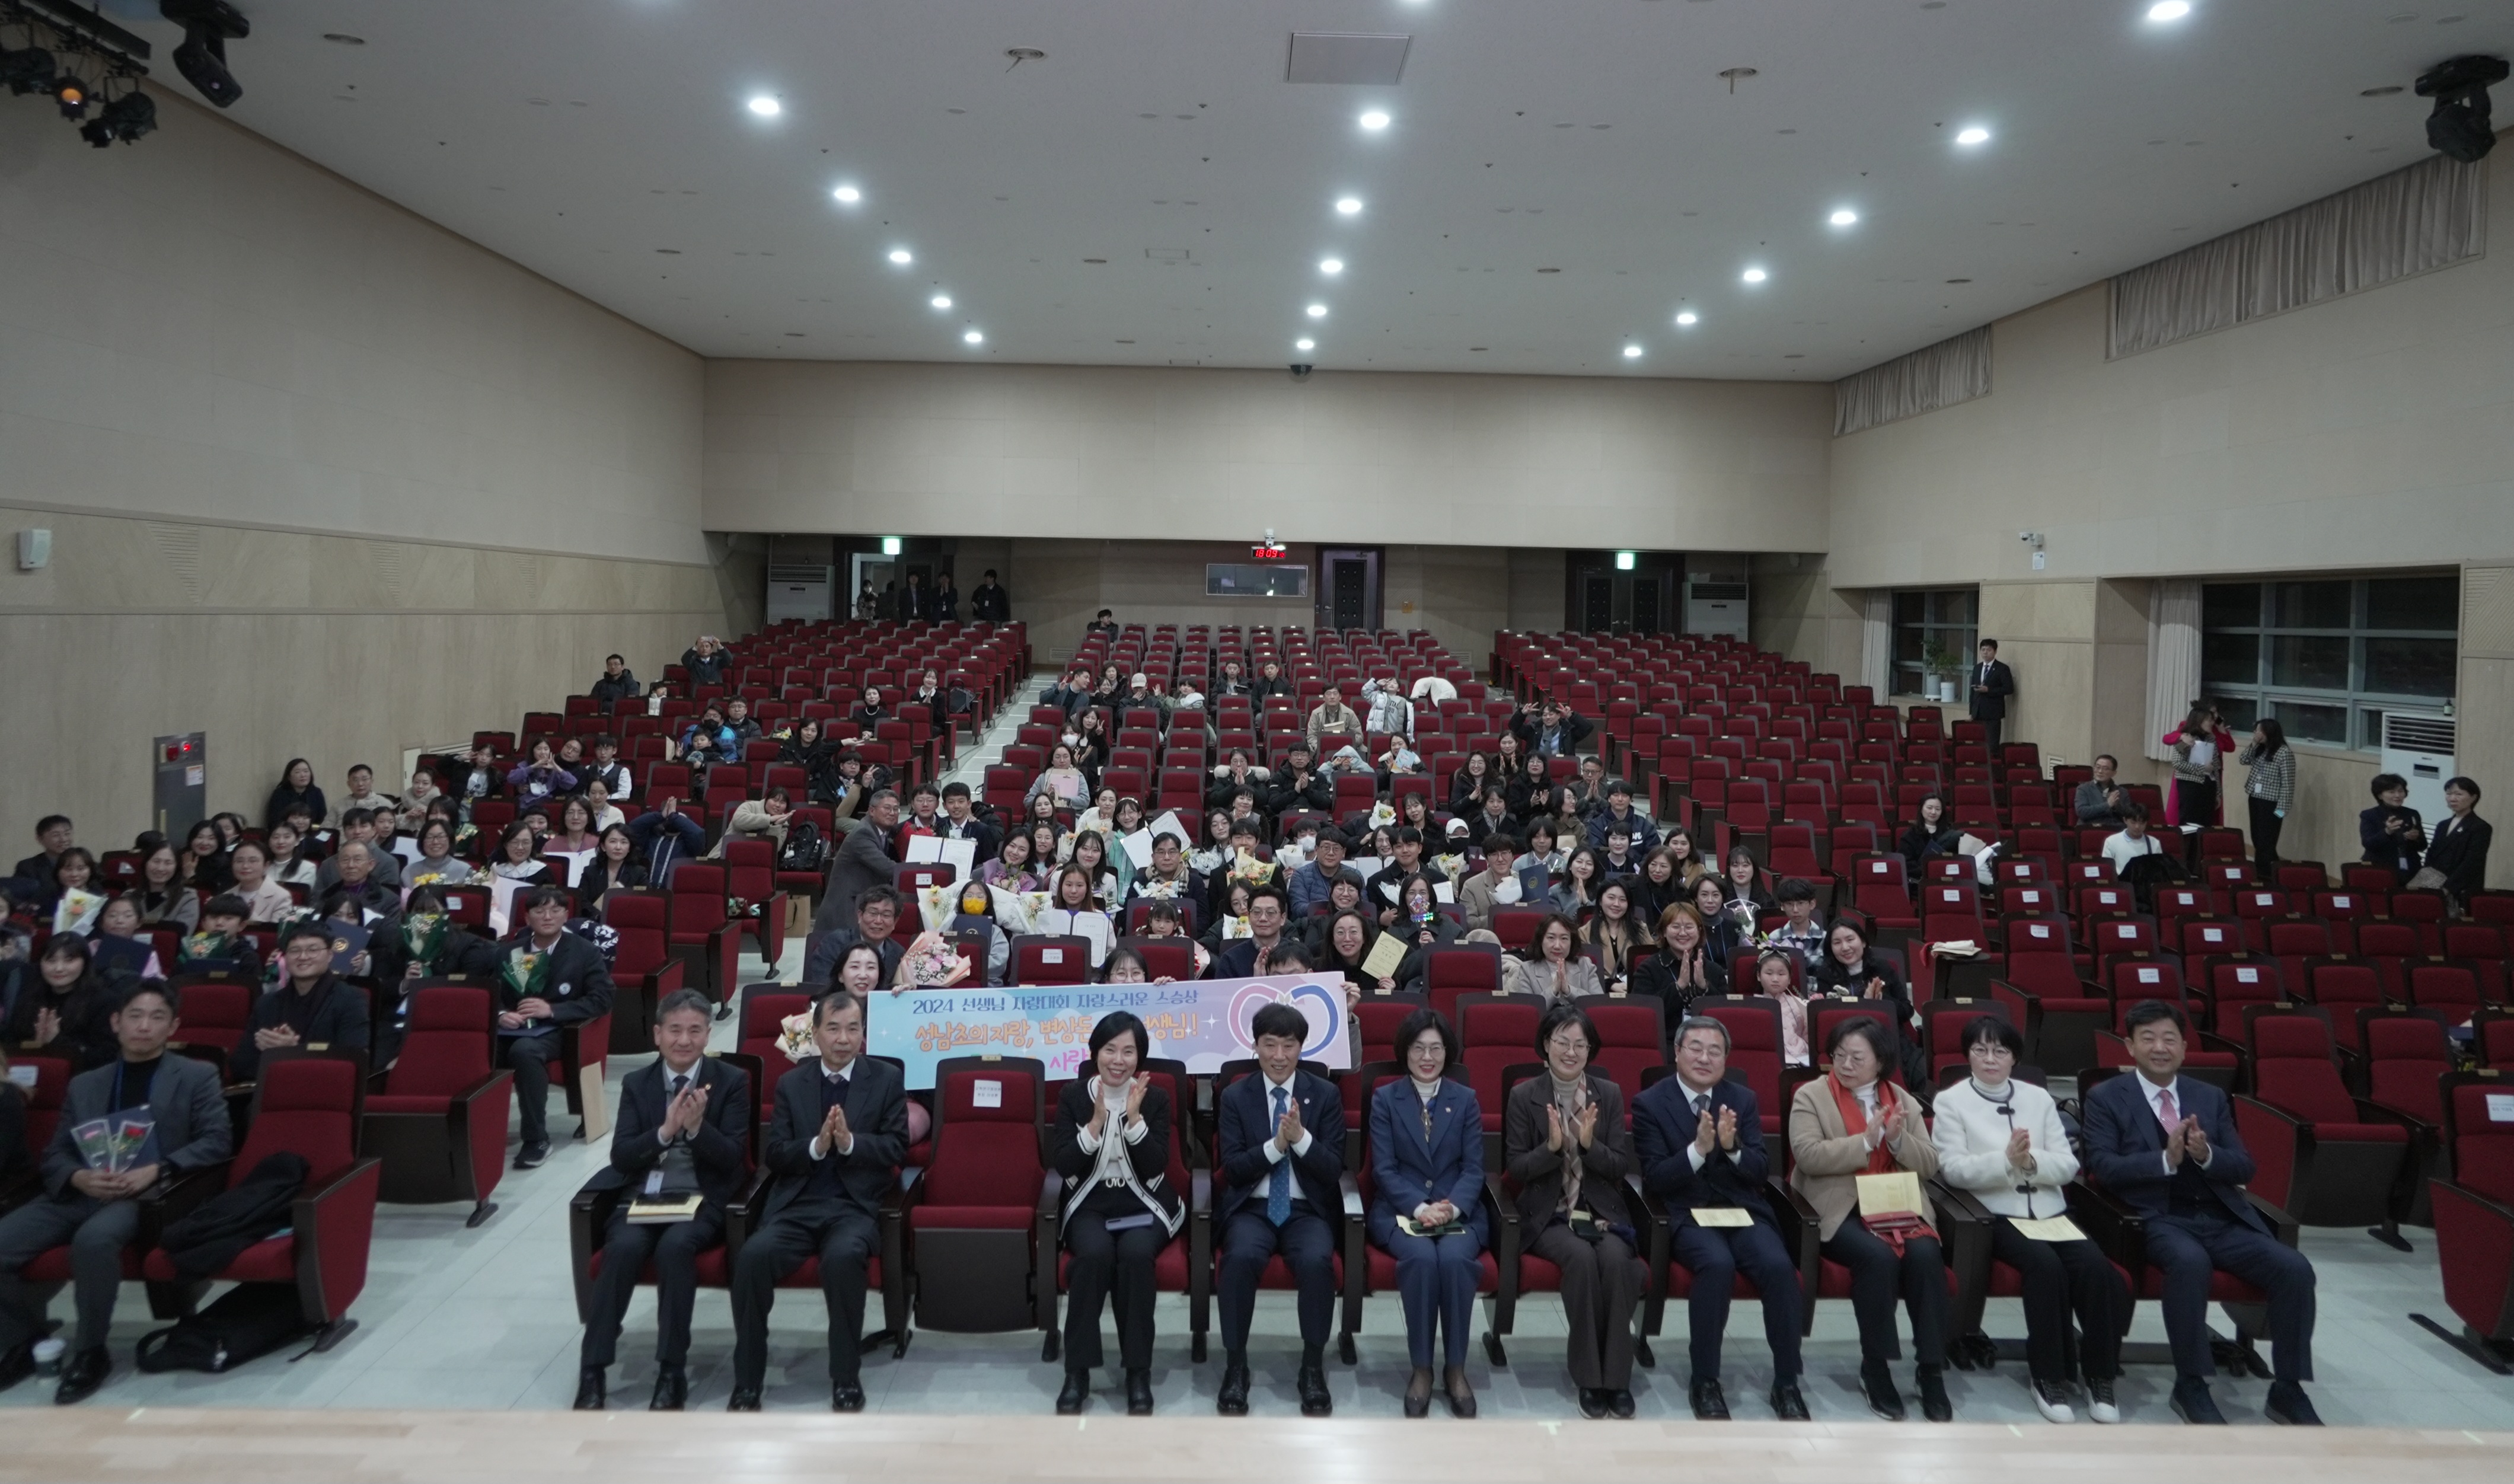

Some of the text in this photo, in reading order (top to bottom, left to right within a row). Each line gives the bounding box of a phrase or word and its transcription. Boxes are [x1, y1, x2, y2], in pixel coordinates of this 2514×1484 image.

[913, 990, 1199, 1014] 2024 선생님 자랑대회 자랑스러운 스승상
[1039, 1016, 1093, 1045] 변상돈
